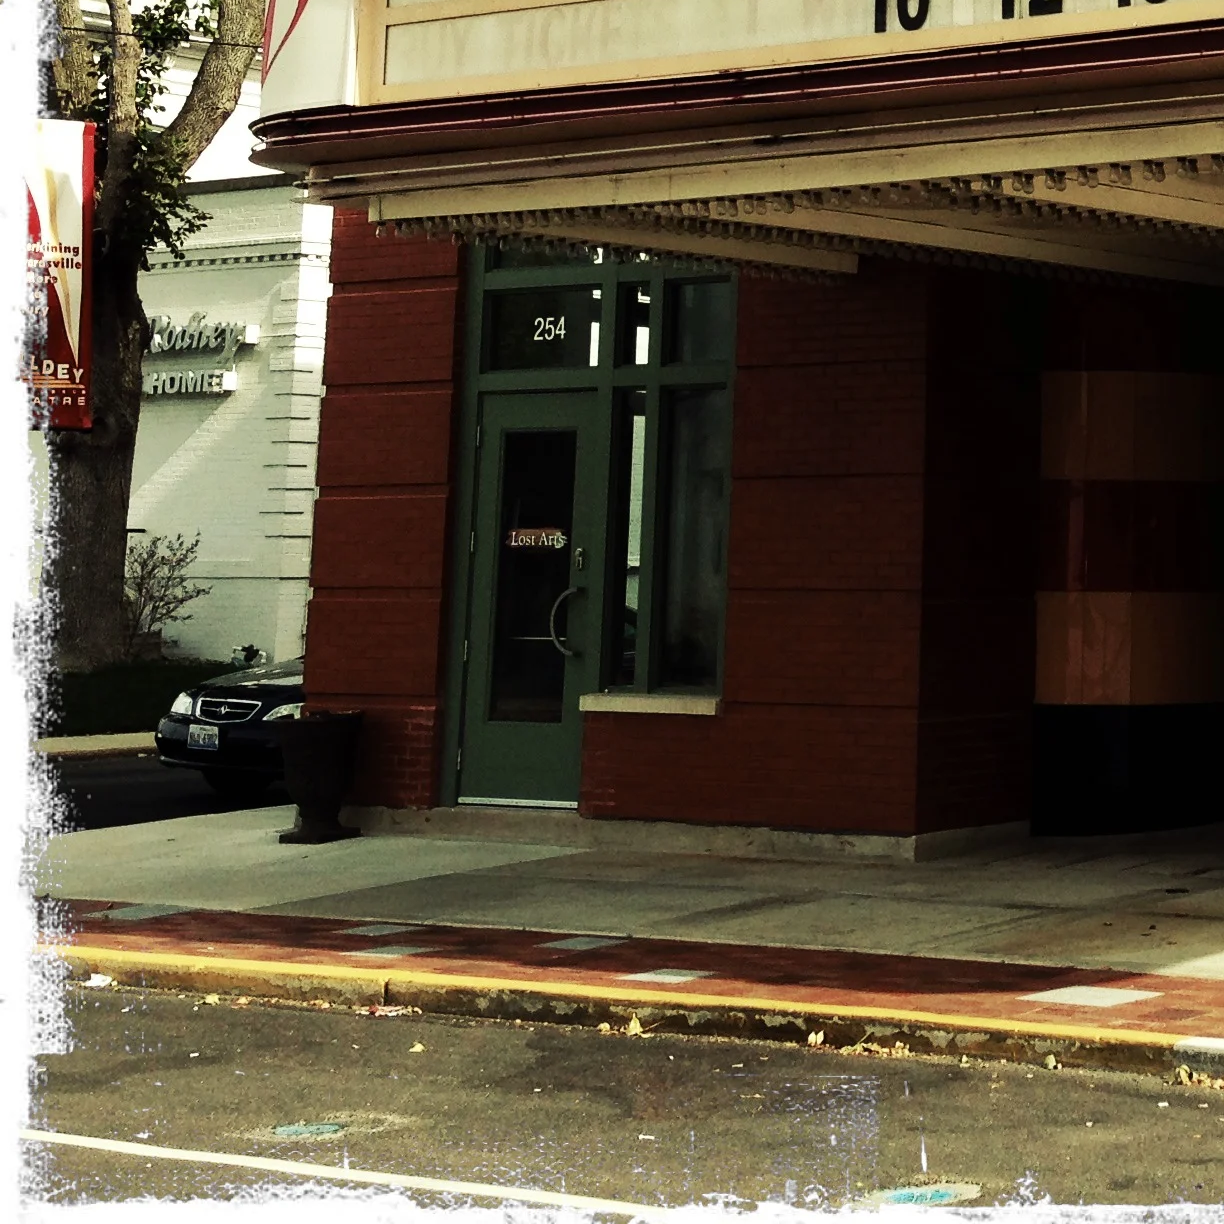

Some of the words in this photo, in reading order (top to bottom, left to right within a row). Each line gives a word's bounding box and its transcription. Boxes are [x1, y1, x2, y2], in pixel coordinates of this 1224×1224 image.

[533, 316, 567, 341] 254
[148, 369, 224, 395] HOME
[510, 531, 536, 546] Lost
[538, 531, 565, 548] Arts
